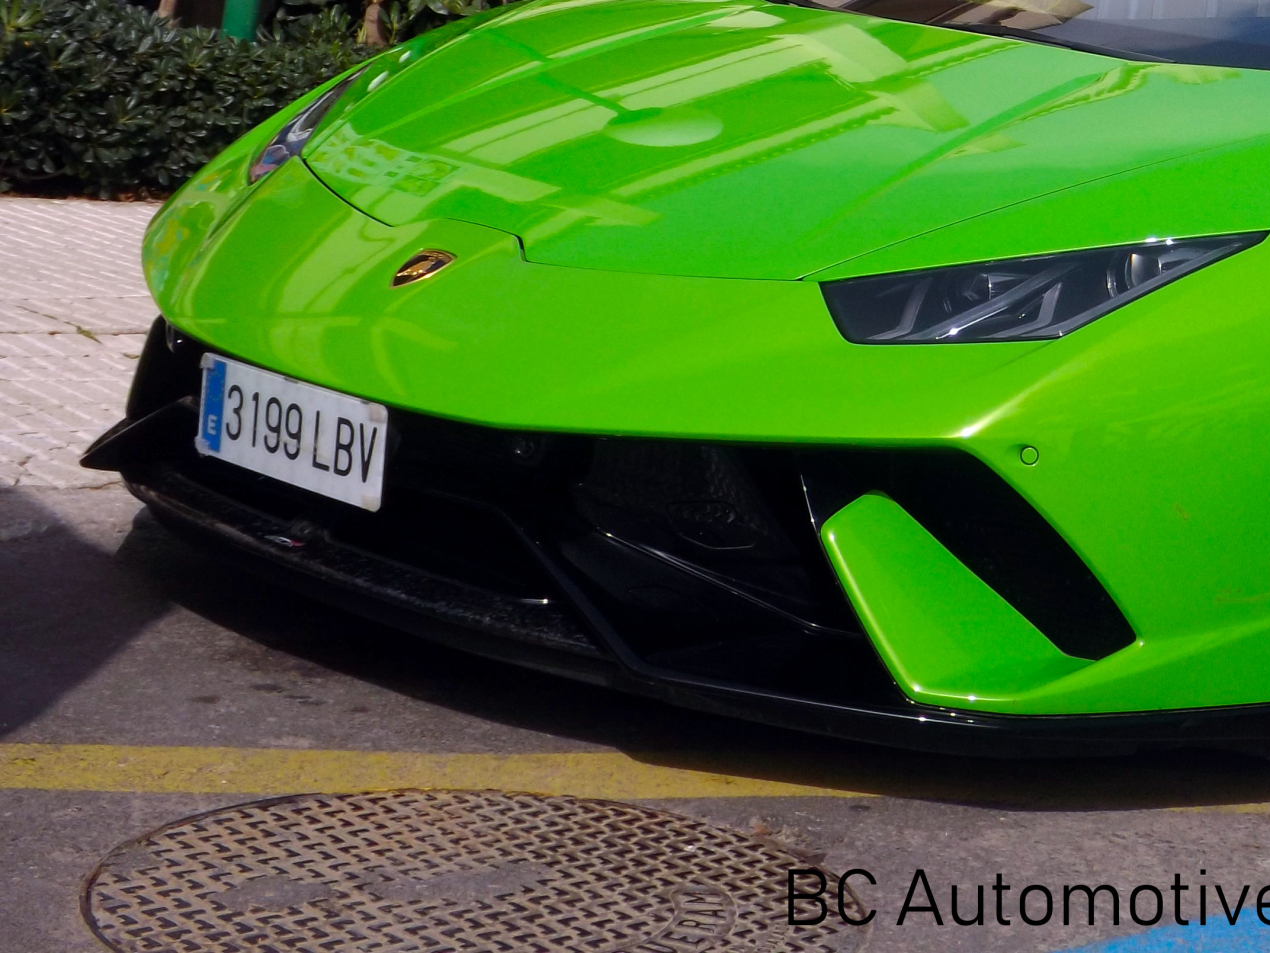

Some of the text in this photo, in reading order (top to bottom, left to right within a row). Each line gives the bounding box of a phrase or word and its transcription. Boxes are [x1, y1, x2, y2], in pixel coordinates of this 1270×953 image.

[207, 414, 218, 436] E
[226, 383, 378, 484] 3199 LBV
